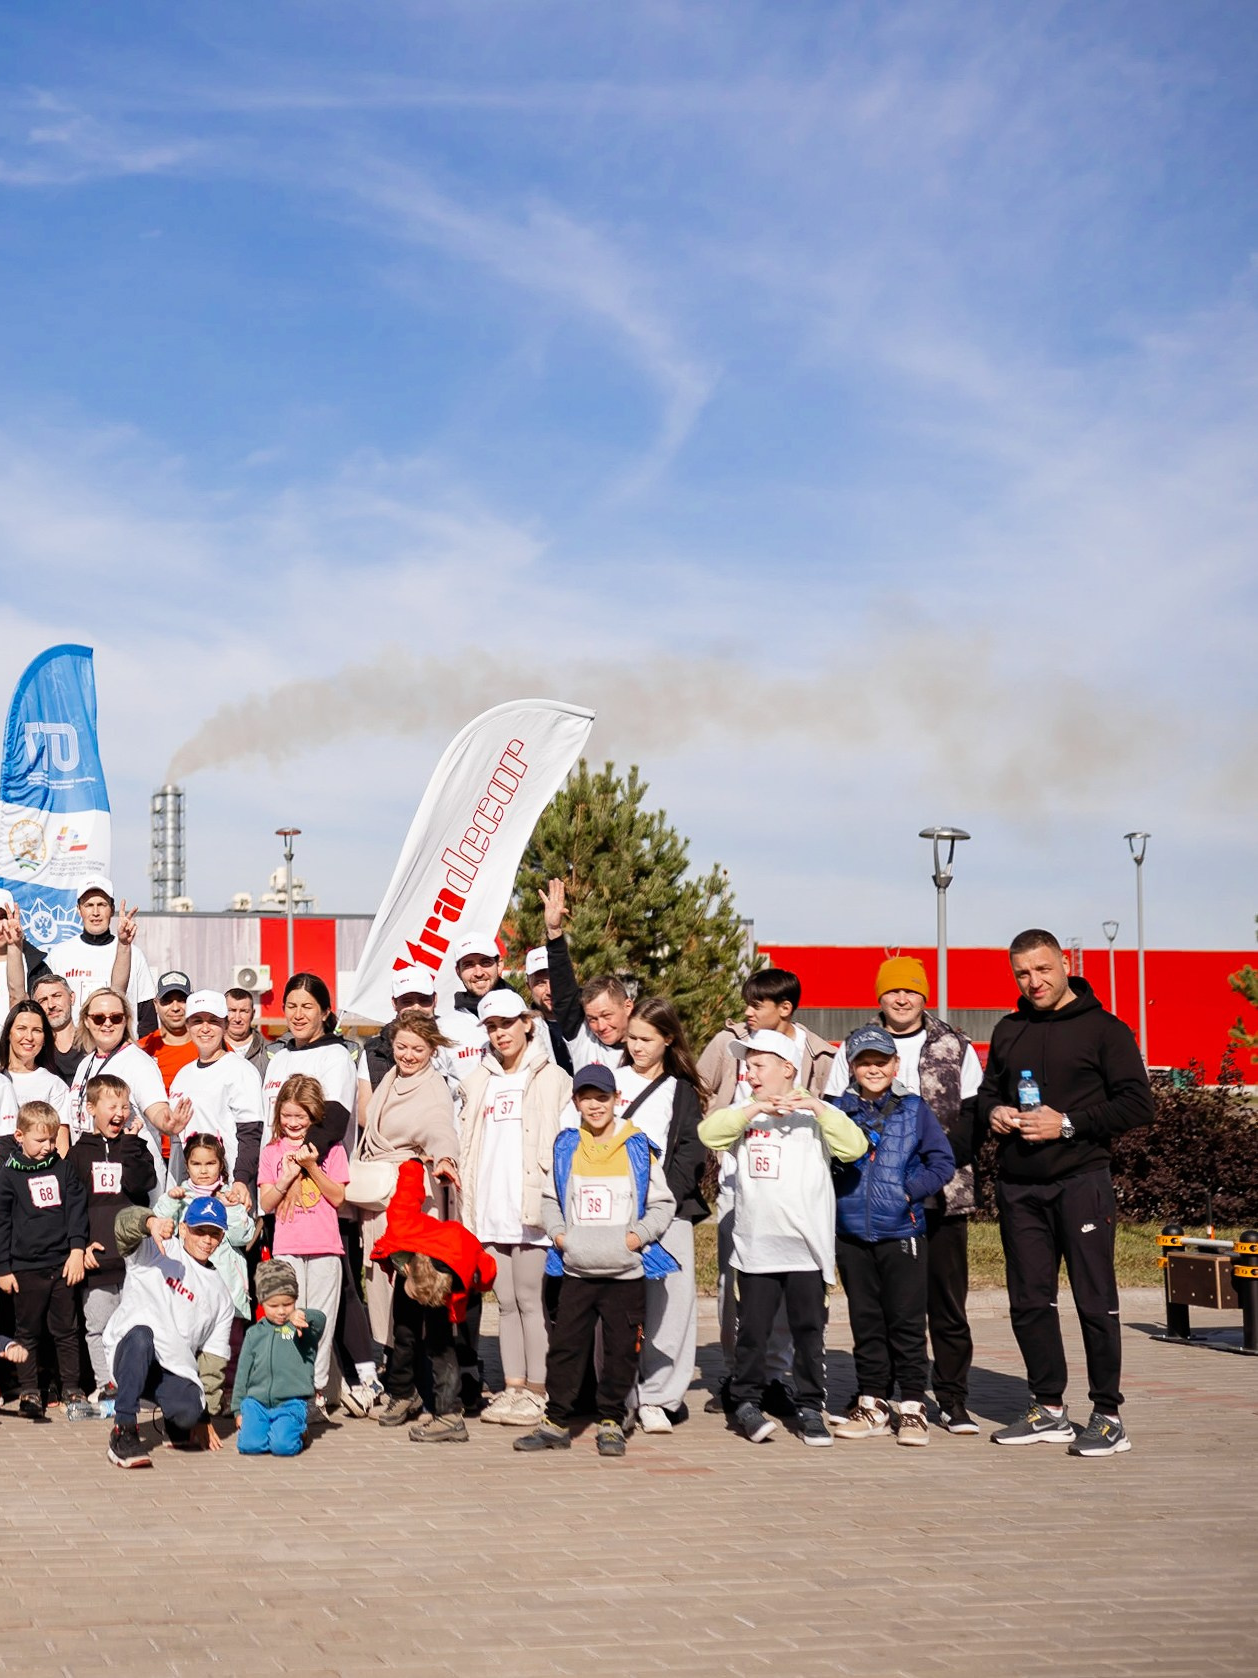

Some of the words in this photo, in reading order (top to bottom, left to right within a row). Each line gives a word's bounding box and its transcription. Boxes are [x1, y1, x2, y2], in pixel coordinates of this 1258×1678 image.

[393, 739, 528, 981] tradecor
[502, 1101, 514, 1115] 37
[755, 1156, 770, 1172] 65
[39, 1187, 55, 1202] 68
[587, 1197, 602, 1213] 38
[166, 1276, 195, 1302] ultra
